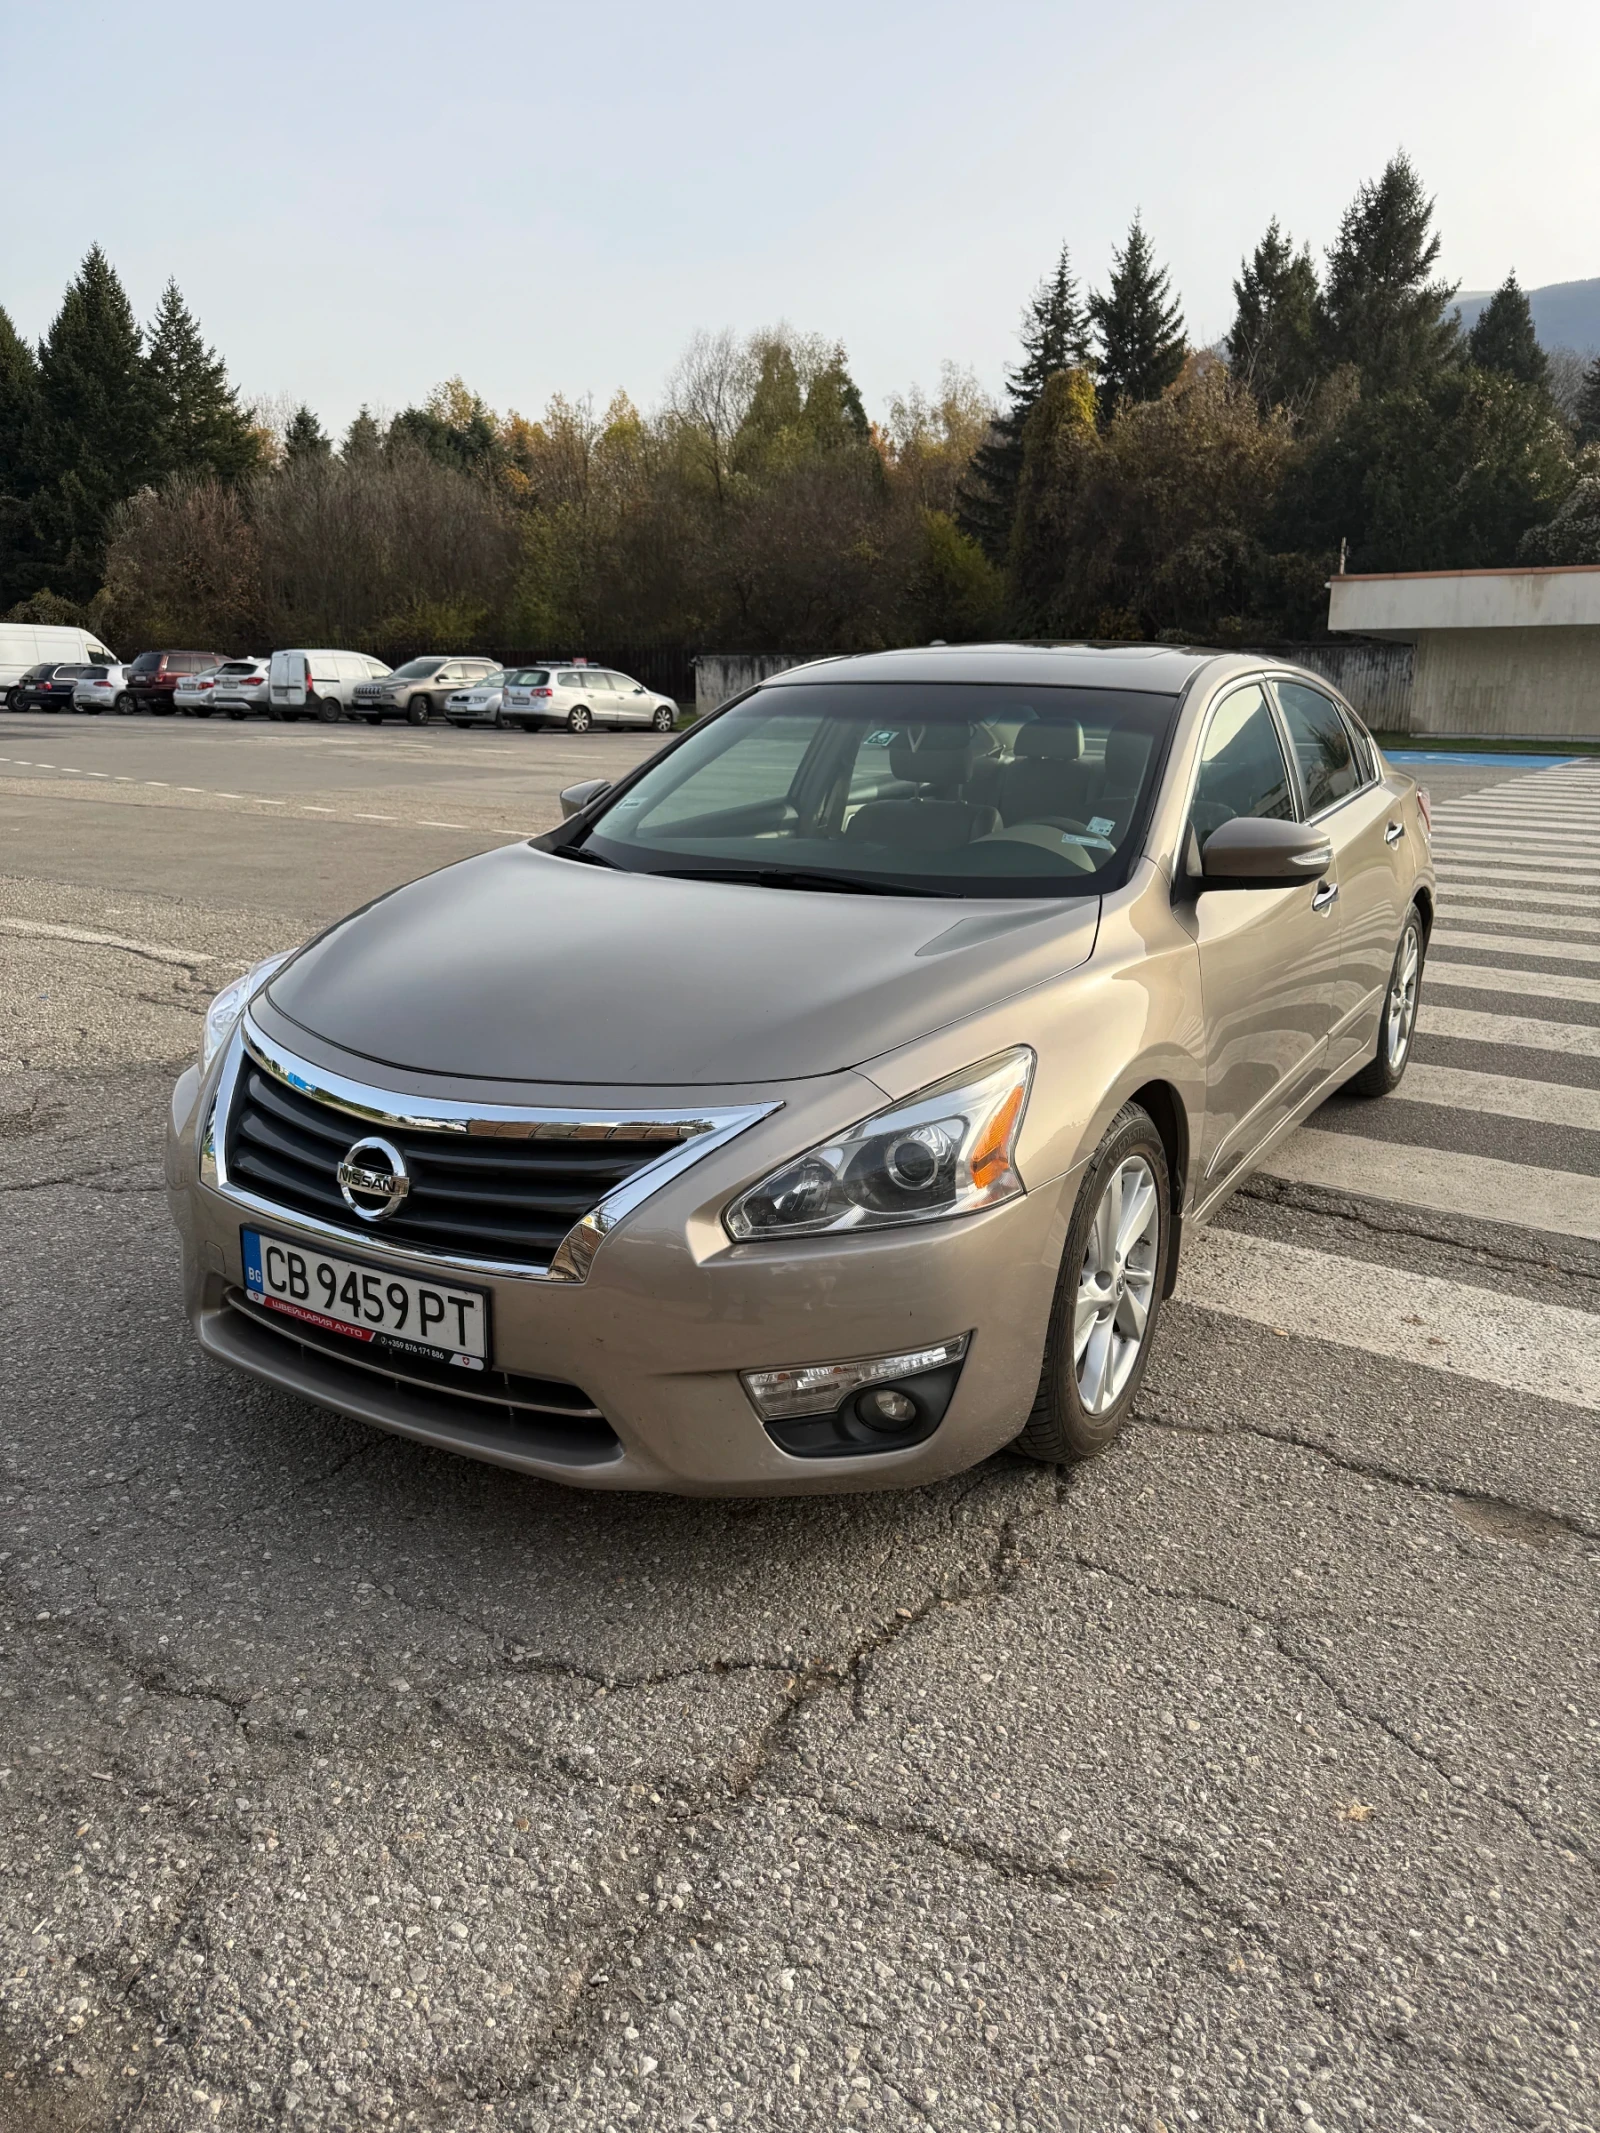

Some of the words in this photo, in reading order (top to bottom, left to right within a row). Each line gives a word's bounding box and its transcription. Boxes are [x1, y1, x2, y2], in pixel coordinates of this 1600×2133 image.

[339, 1167, 396, 1193] NISSAN
[248, 1266, 262, 1283] BG
[266, 1246, 310, 1300] CB
[317, 1263, 409, 1330] 9459
[419, 1288, 475, 1347] PT
[271, 1300, 333, 1328] ШВЕЙЦАРИЯ
[334, 1323, 363, 1337] АУТО
[388, 1340, 404, 1349] +359
[404, 1343, 418, 1353] 876
[419, 1346, 431, 1356] 171
